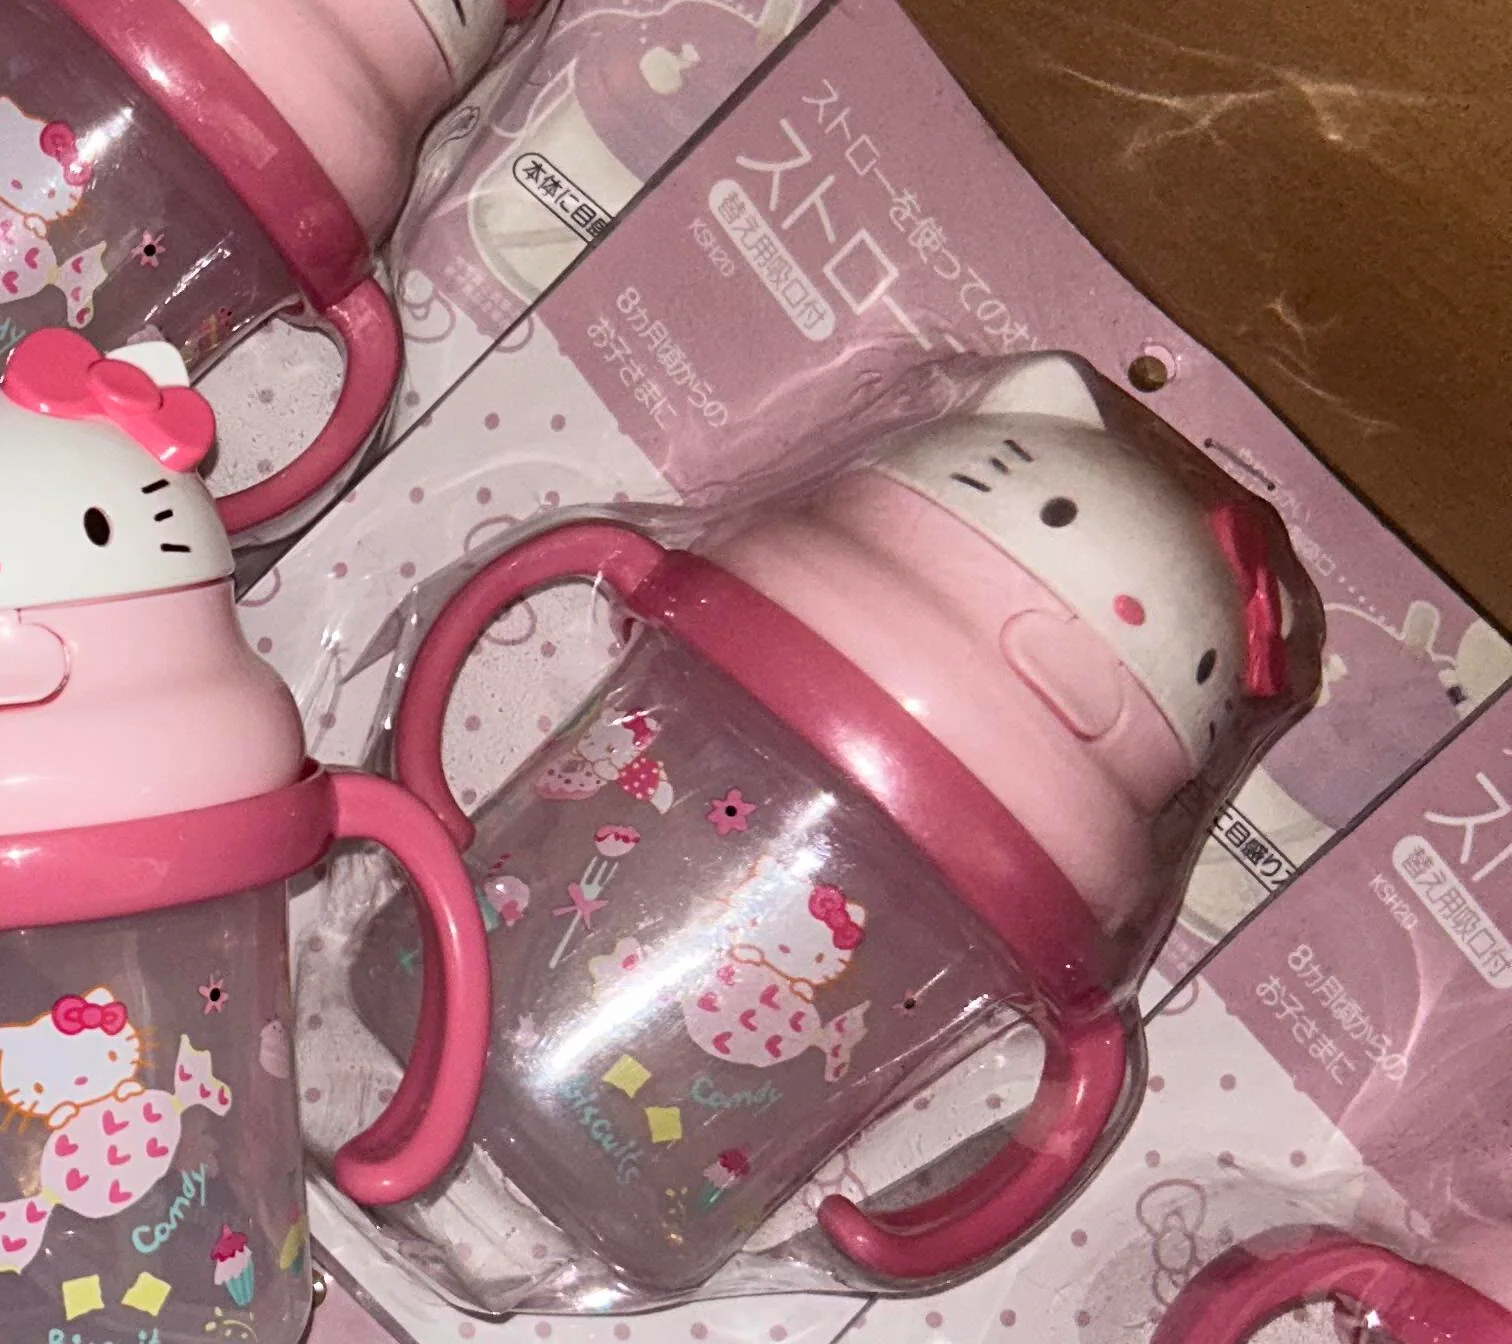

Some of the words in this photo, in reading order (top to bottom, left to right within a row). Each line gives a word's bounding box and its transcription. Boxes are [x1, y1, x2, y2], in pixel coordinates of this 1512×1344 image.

[736, 118, 965, 354] ストロー
[131, 1163, 208, 1254] Candy
